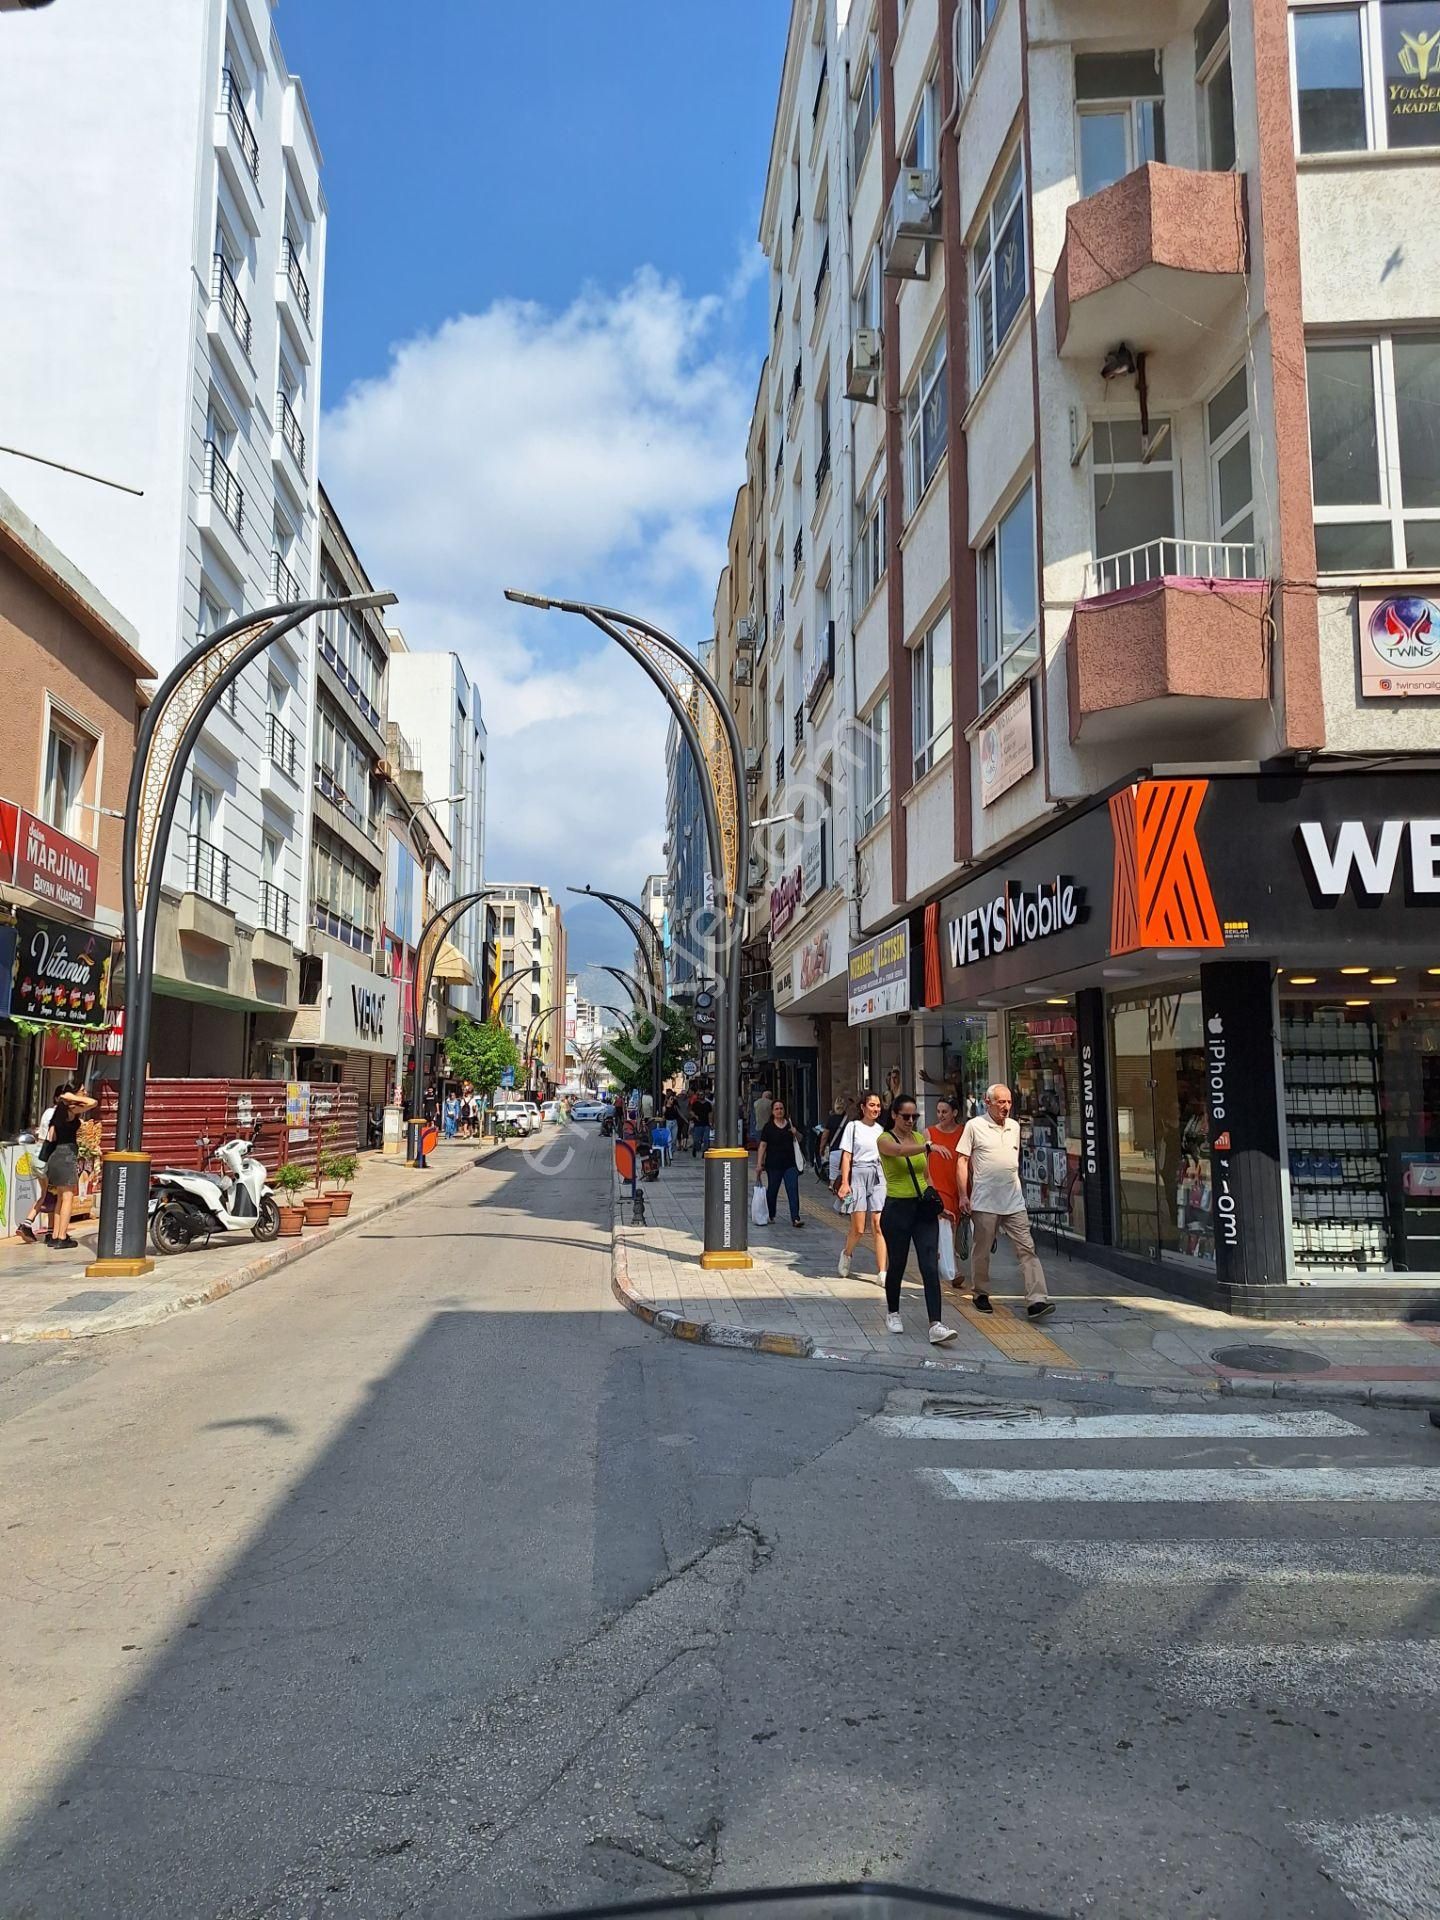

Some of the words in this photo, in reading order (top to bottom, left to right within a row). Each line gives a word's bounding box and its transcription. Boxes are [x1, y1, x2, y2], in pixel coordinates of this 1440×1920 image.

[1387, 645, 1433, 657] TWINS
[27, 836, 91, 892] MARJİNAL
[33, 873, 55, 898] BAYAN
[55, 883, 83, 910] KUAFÖRÜ
[30, 931, 90, 984] Vitamin
[1209, 1040, 1226, 1119] iPhone
[1082, 1045, 1097, 1174] SAMSUNG
[118, 1166, 127, 1208] BELEDİYESİ
[723, 1161, 731, 1202] BELEDİYESİ
[114, 1210, 125, 1256] İSKENDERUN
[723, 1203, 731, 1248] İSKENDERUN
